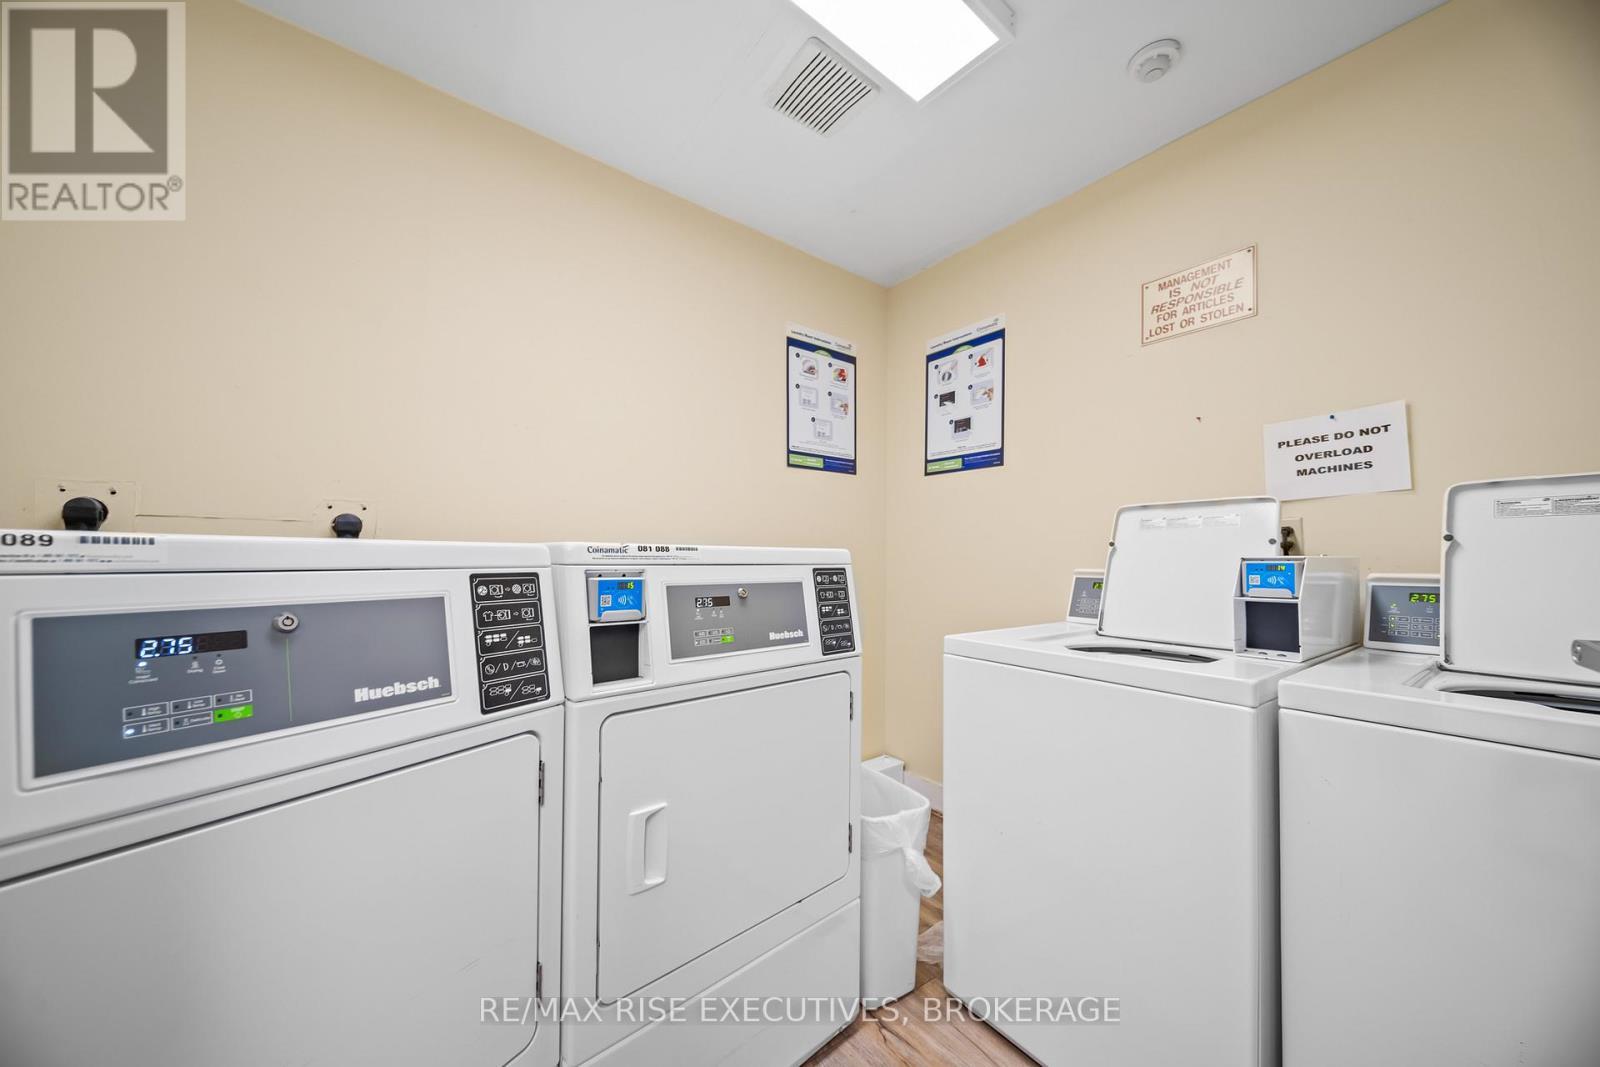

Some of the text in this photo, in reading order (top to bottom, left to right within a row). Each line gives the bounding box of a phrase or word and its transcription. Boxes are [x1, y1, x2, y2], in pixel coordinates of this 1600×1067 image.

[1158, 258, 1233, 291] MANAGEMENT
[1169, 273, 1220, 298] IS NOT
[1151, 277, 1245, 315] RESPONSIBLE
[1156, 292, 1235, 323] FOR ARTICLES
[1149, 302, 1244, 338] LOST OR STOLEN
[1277, 424, 1391, 449] PLEASE DO NOT
[1294, 445, 1374, 462] OVERLOAD
[1296, 460, 1374, 477] MACHINES
[1, 533, 54, 547] 089
[587, 545, 630, 554] Coinamatic
[637, 545, 653, 553] 081
[769, 629, 804, 641] Huebsch
[354, 676, 441, 703] Huebsch
